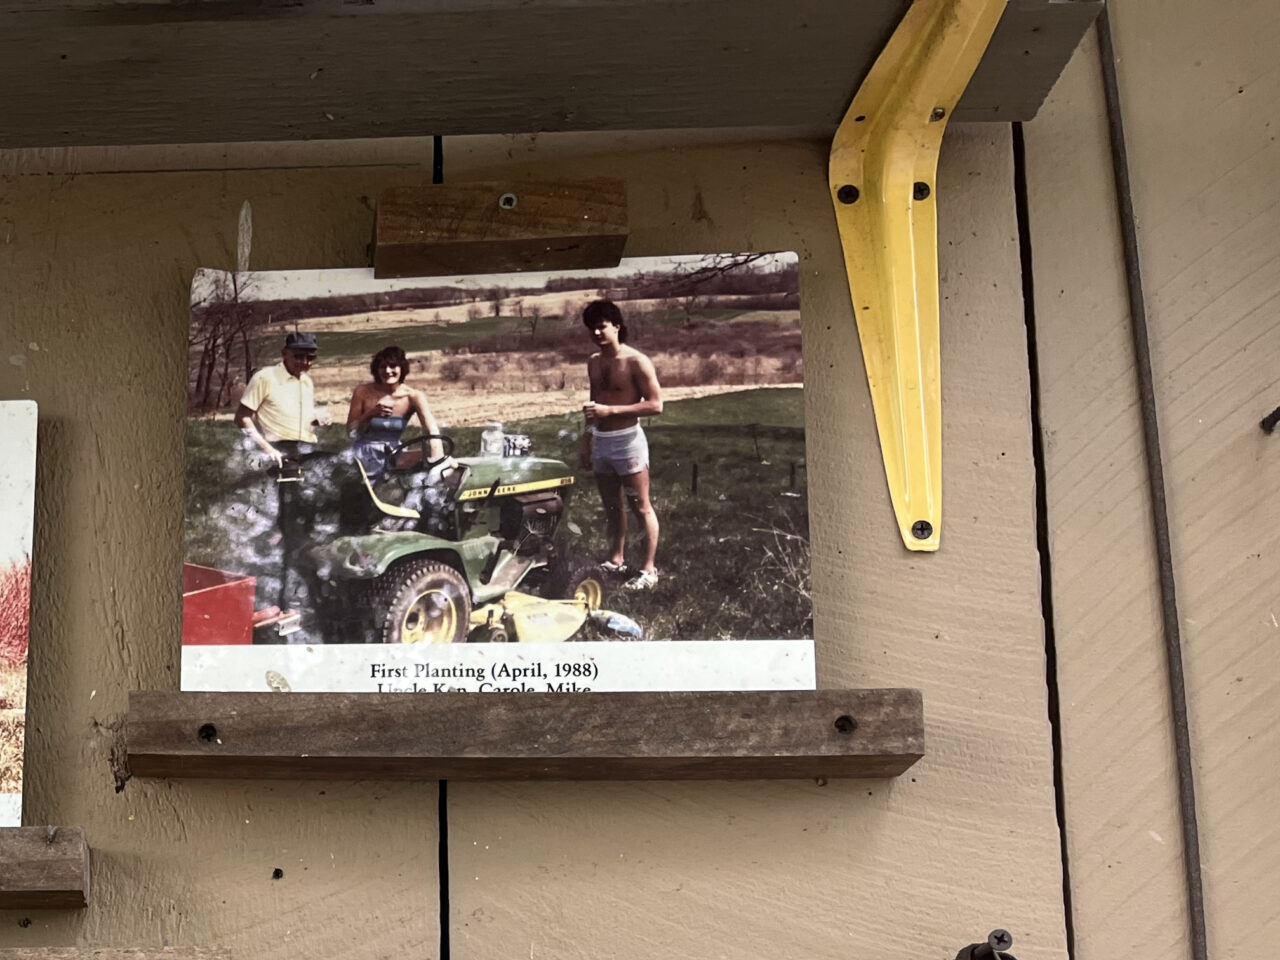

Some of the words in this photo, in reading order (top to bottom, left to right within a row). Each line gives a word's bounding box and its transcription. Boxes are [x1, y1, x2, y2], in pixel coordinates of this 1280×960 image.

[370, 663, 408, 678] First
[414, 662, 486, 681] Planting
[491, 662, 548, 681] (April,
[554, 662, 599, 680] 1988)
